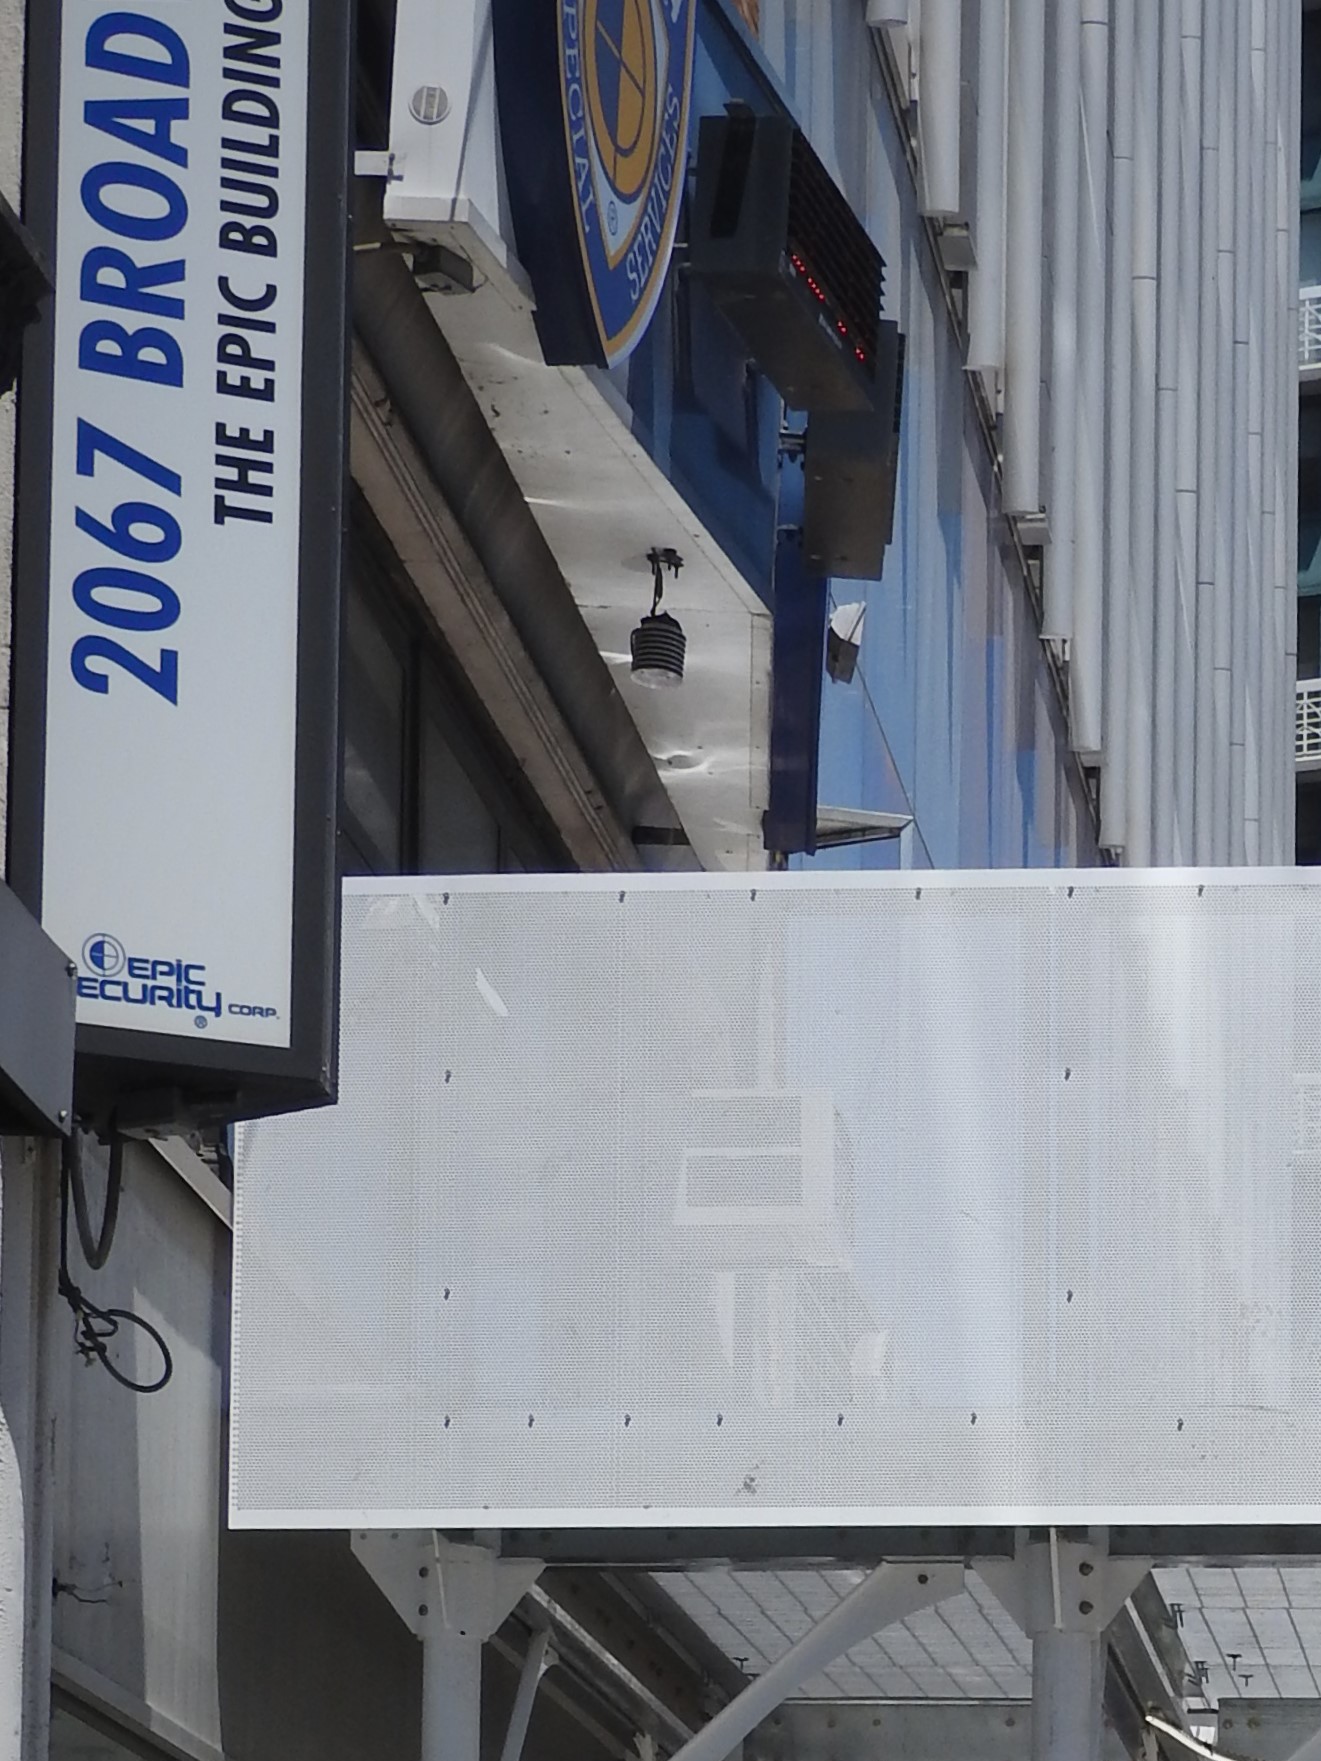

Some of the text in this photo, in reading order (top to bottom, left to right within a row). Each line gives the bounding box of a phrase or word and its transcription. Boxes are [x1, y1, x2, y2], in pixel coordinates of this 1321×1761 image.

[625, 83, 681, 304] SERVICES
[70, 11, 190, 706] 2067 BROAD
[216, 275, 278, 402] EPIC
[214, 421, 275, 526] THE
